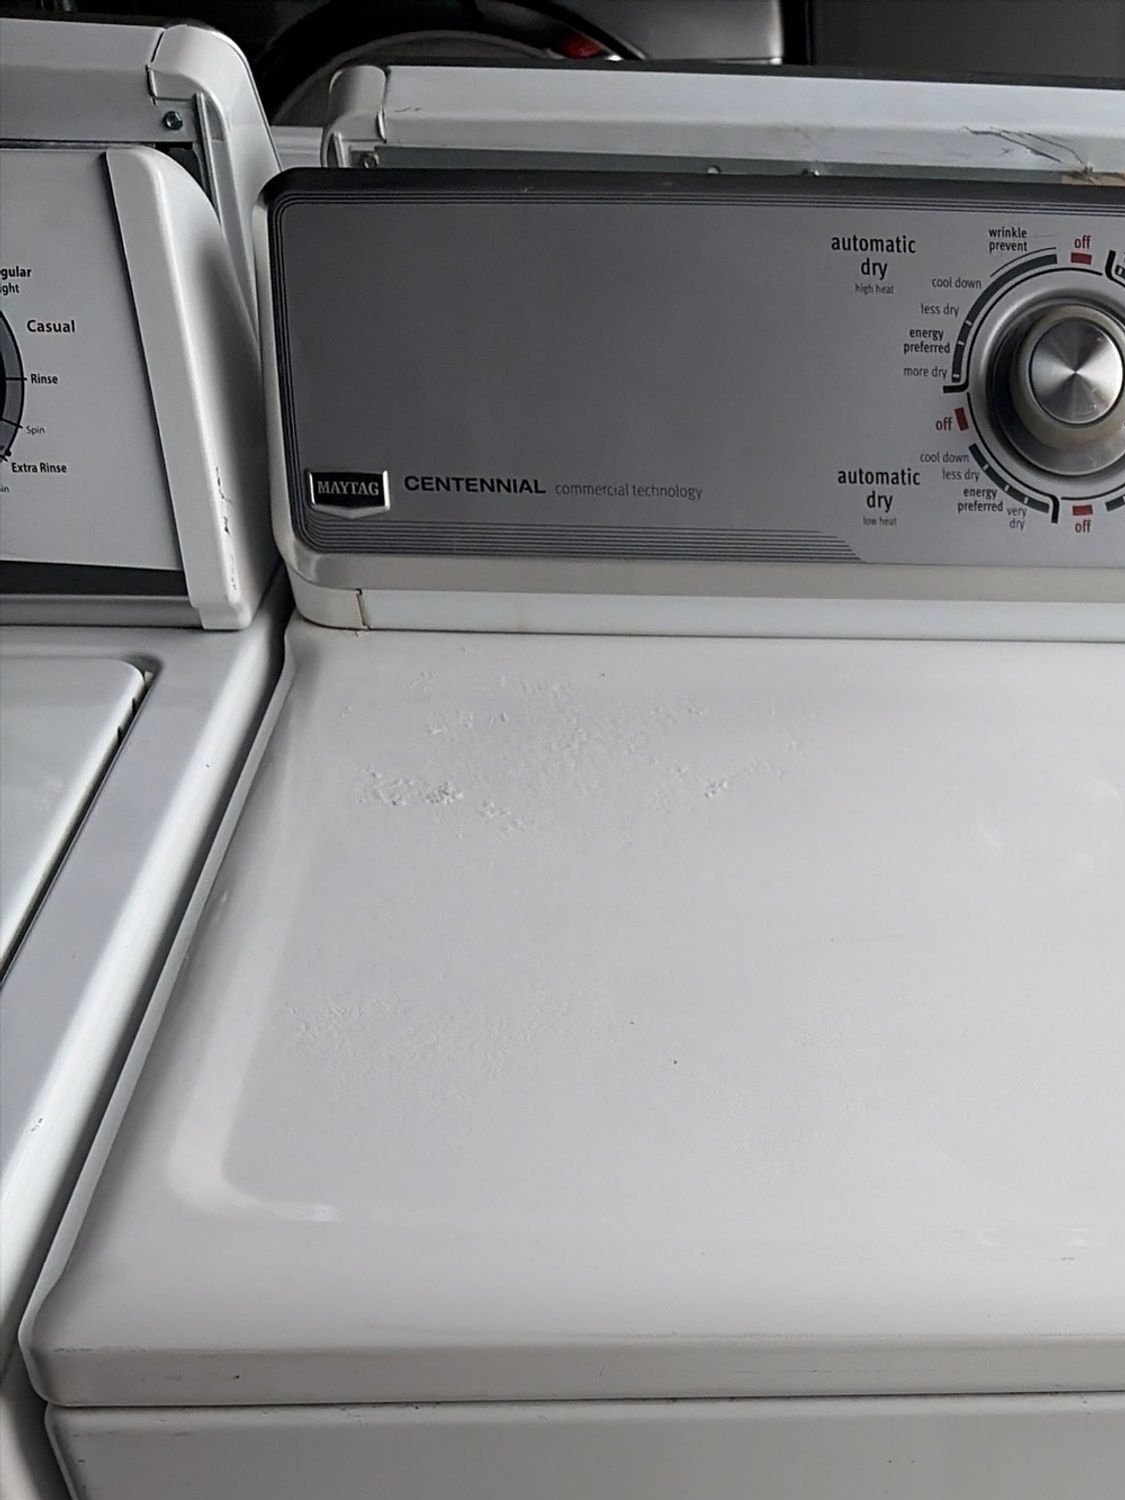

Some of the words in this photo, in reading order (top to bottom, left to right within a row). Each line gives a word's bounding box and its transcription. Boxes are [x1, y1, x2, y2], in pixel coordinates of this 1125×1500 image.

[988, 226, 1028, 239] wrinkle
[831, 234, 917, 254] automatic
[988, 240, 1028, 254] prevent
[1073, 234, 1092, 249] off
[0, 265, 32, 280] gular
[860, 257, 888, 281] dry
[855, 283, 874, 296] high
[875, 284, 895, 295] heat
[932, 276, 952, 288] cool
[954, 277, 982, 289] down
[920, 302, 941, 316] less
[942, 302, 960, 318] dry
[26, 319, 76, 333] Casual
[908, 328, 944, 341] energy
[903, 341, 951, 355] preferred
[30, 373, 59, 385] Rinse
[903, 366, 930, 377] more
[931, 366, 948, 380] dry
[26, 425, 46, 437] Spin
[935, 417, 953, 431] off
[920, 452, 941, 464] cool
[942, 452, 970, 464] down
[11, 462, 38, 473] Extra
[39, 461, 68, 473] Rinse
[837, 467, 921, 486] automatic
[942, 468, 963, 481] less
[963, 468, 981, 483] dry
[317, 479, 380, 496] MAYTAG
[403, 475, 547, 494] CENTENNIAL
[554, 483, 630, 497] commercial
[631, 483, 703, 501] technology
[963, 487, 998, 500] energy
[866, 489, 894, 513] dry
[957, 500, 1004, 513] preferred
[1006, 507, 1028, 519] very
[862, 515, 878, 527] low
[878, 515, 897, 527] heat
[1009, 517, 1026, 531] dry
[1074, 519, 1092, 534] off
